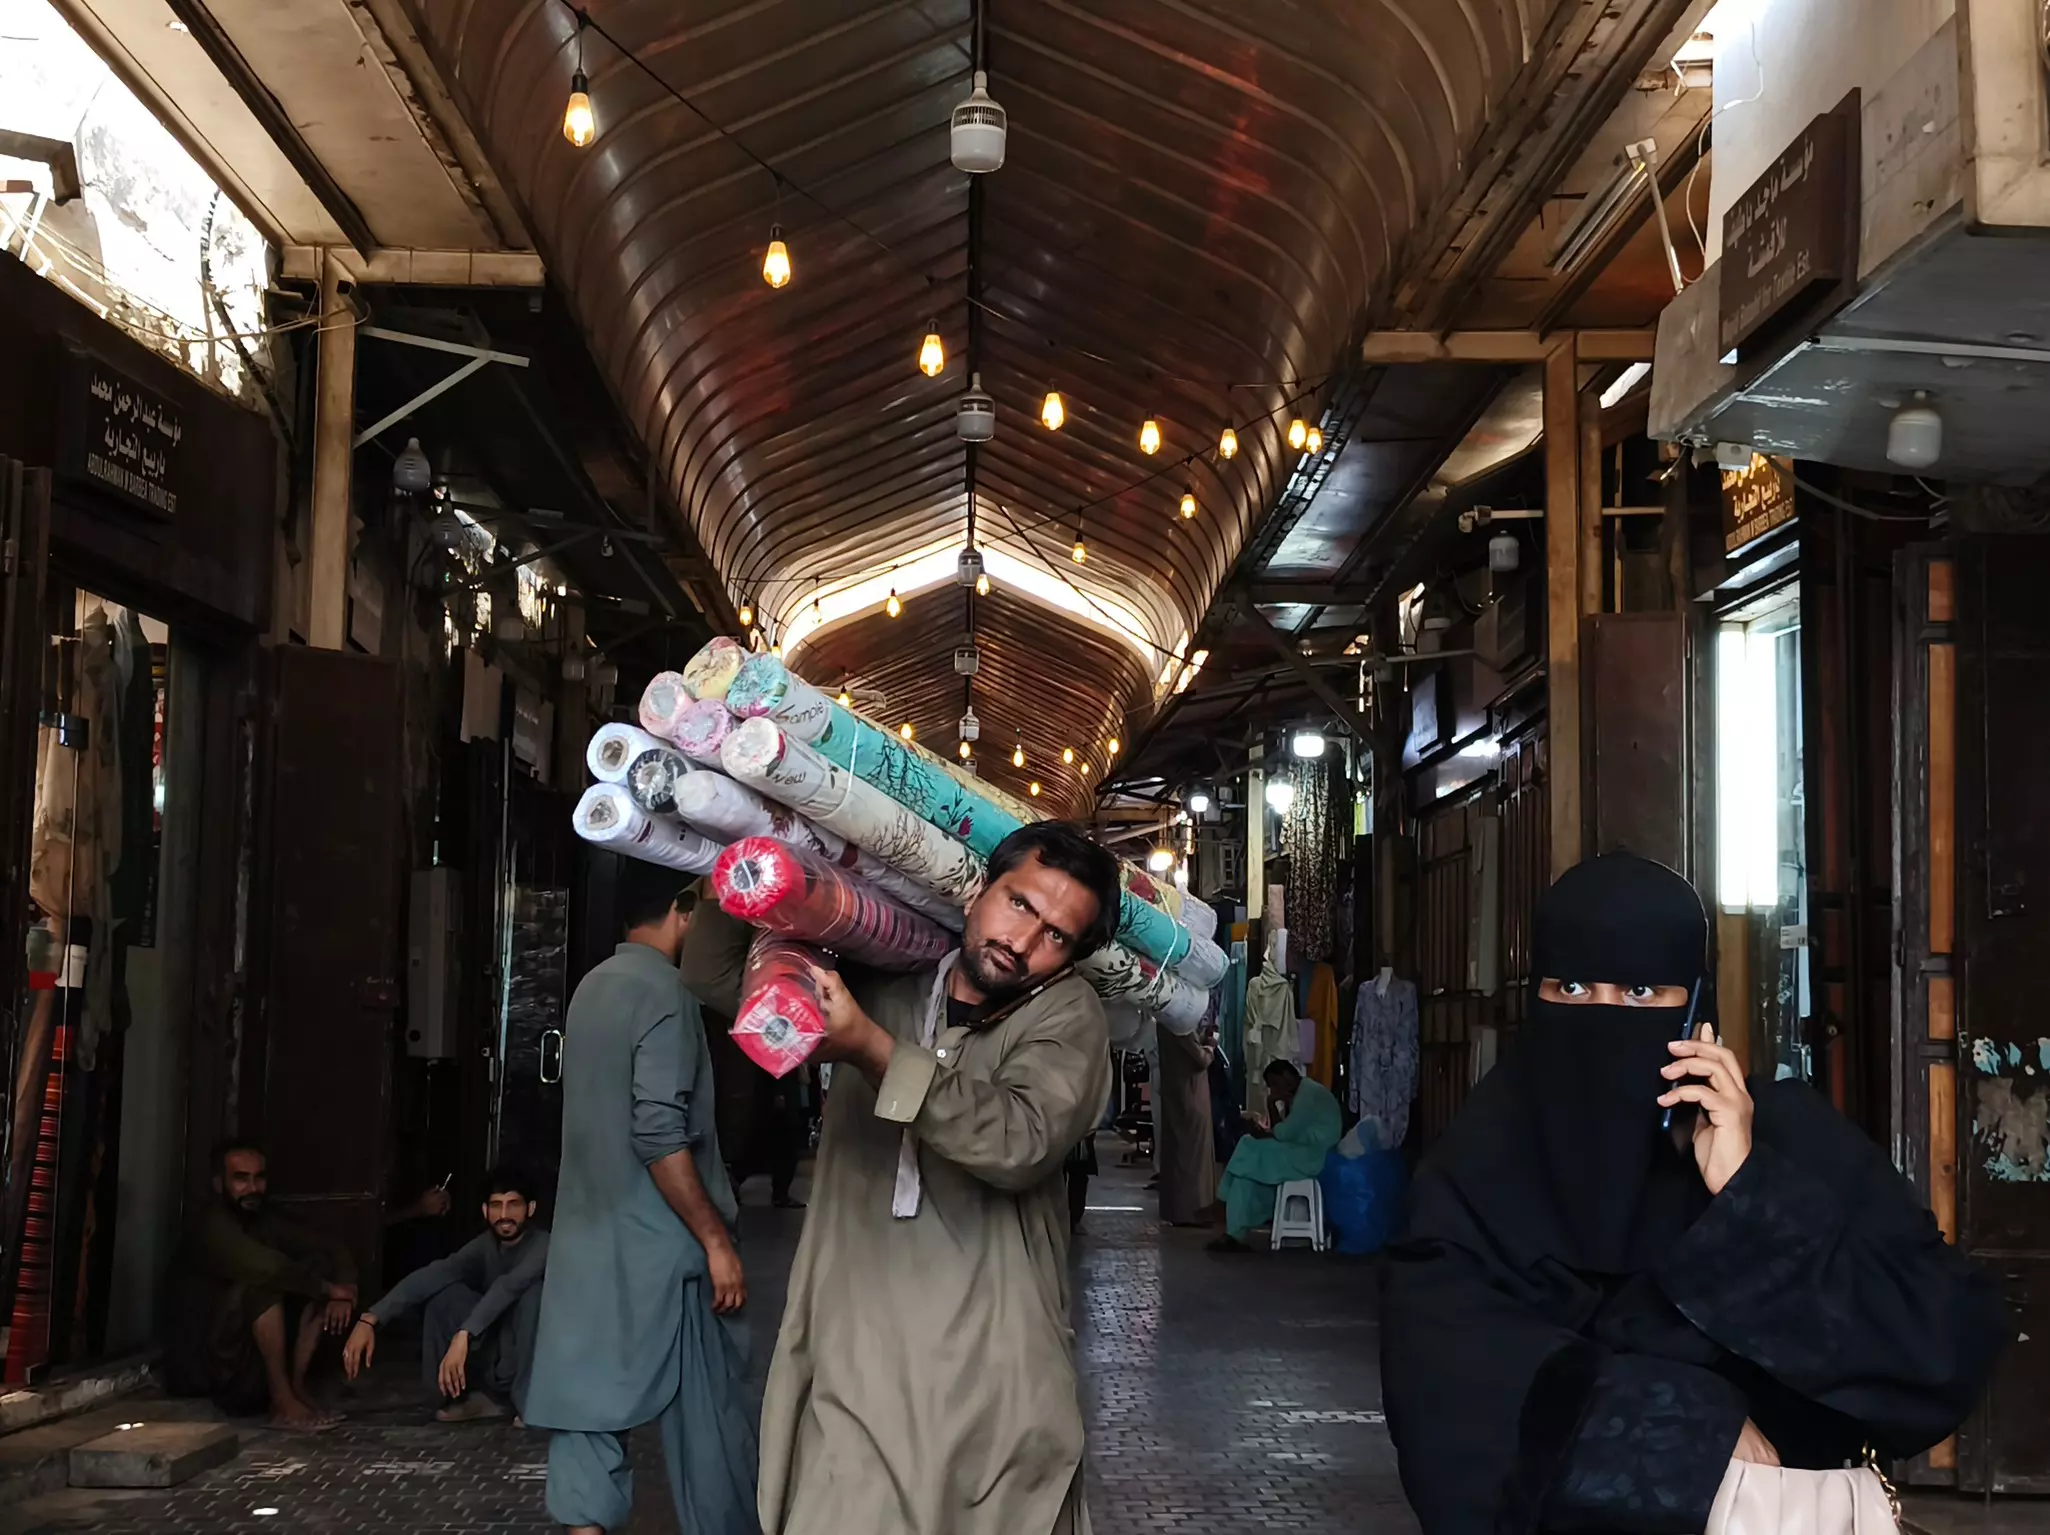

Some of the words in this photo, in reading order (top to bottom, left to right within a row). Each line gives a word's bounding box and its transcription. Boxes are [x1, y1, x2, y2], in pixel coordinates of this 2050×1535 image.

[90, 372, 113, 402] محمد
[104, 416, 141, 464] التجارية
[157, 404, 182, 447] مؤسسة
[140, 447, 166, 483] باربيع
